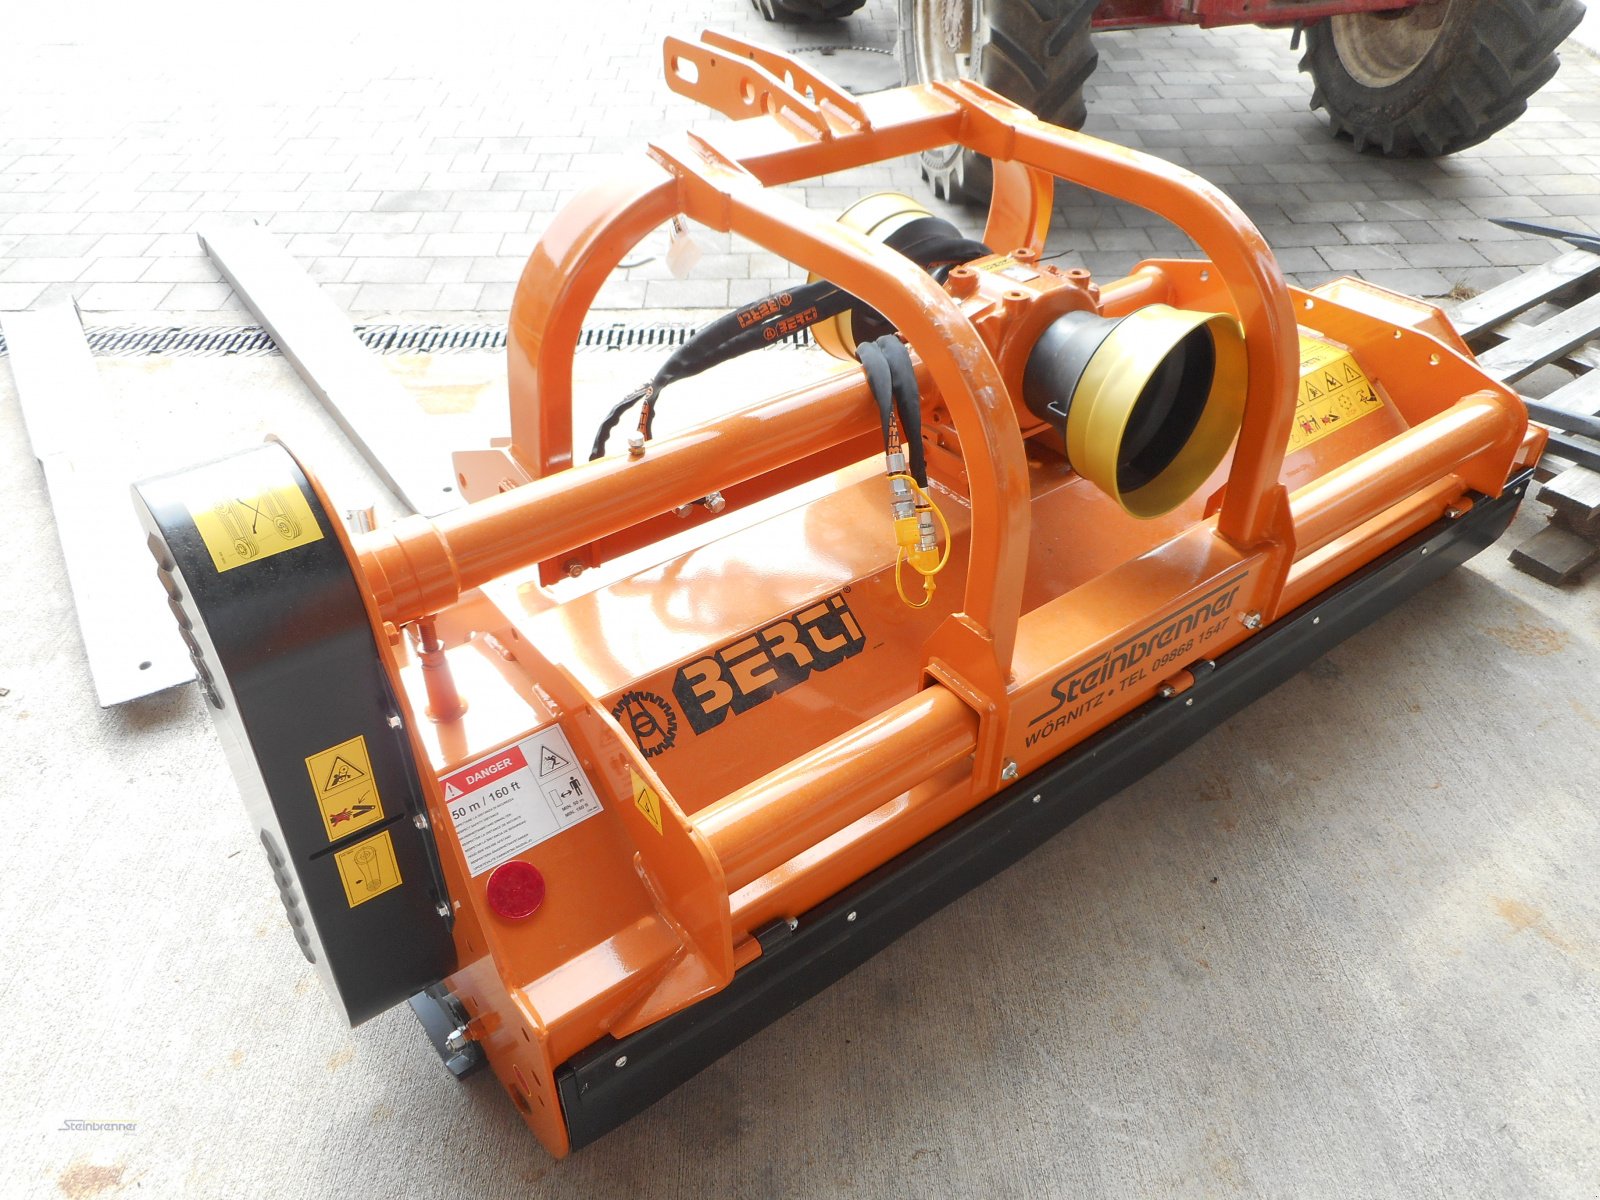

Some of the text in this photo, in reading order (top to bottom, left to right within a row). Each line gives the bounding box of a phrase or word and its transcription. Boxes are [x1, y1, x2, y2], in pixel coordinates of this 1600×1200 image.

[673, 593, 866, 734] BERTI
[1025, 616, 1230, 748] WÖRNITZ TEL 09868 1547
[1029, 572, 1249, 727] Steinbrenner
[452, 807, 466, 820] 50
[469, 802, 480, 812] m
[489, 787, 509, 801] 160
[511, 782, 521, 792] ft
[466, 758, 512, 785] DANGER
